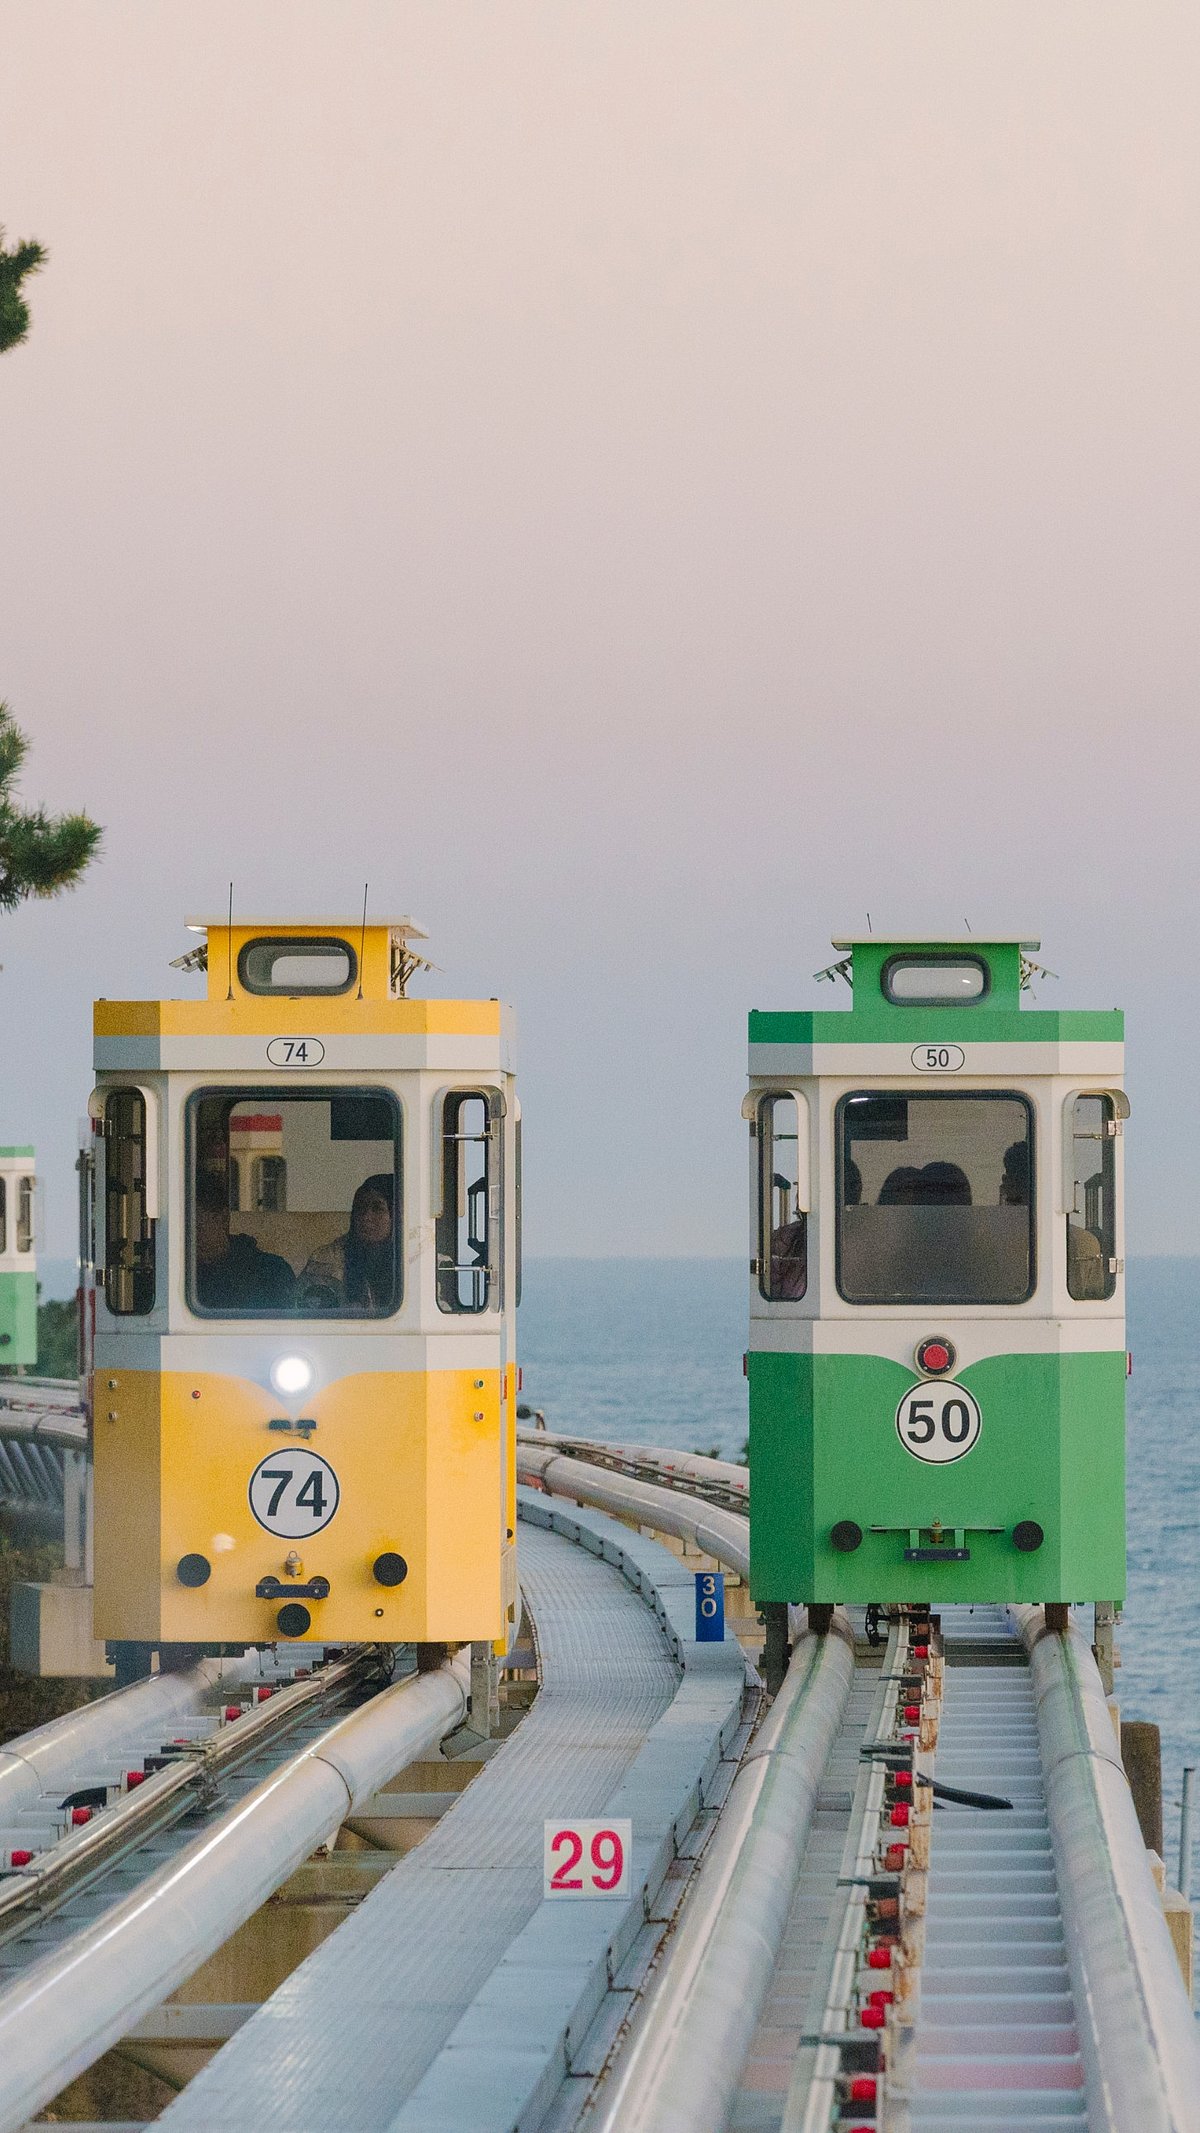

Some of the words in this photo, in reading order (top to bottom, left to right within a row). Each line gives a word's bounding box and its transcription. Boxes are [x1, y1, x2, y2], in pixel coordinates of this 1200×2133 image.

[283, 1043, 308, 1062] 74
[926, 1049, 949, 1067] 50
[907, 1399, 970, 1444] 50
[261, 1470, 327, 1517] 74
[701, 1576, 717, 1617] 30
[551, 1830, 624, 1891] 29
